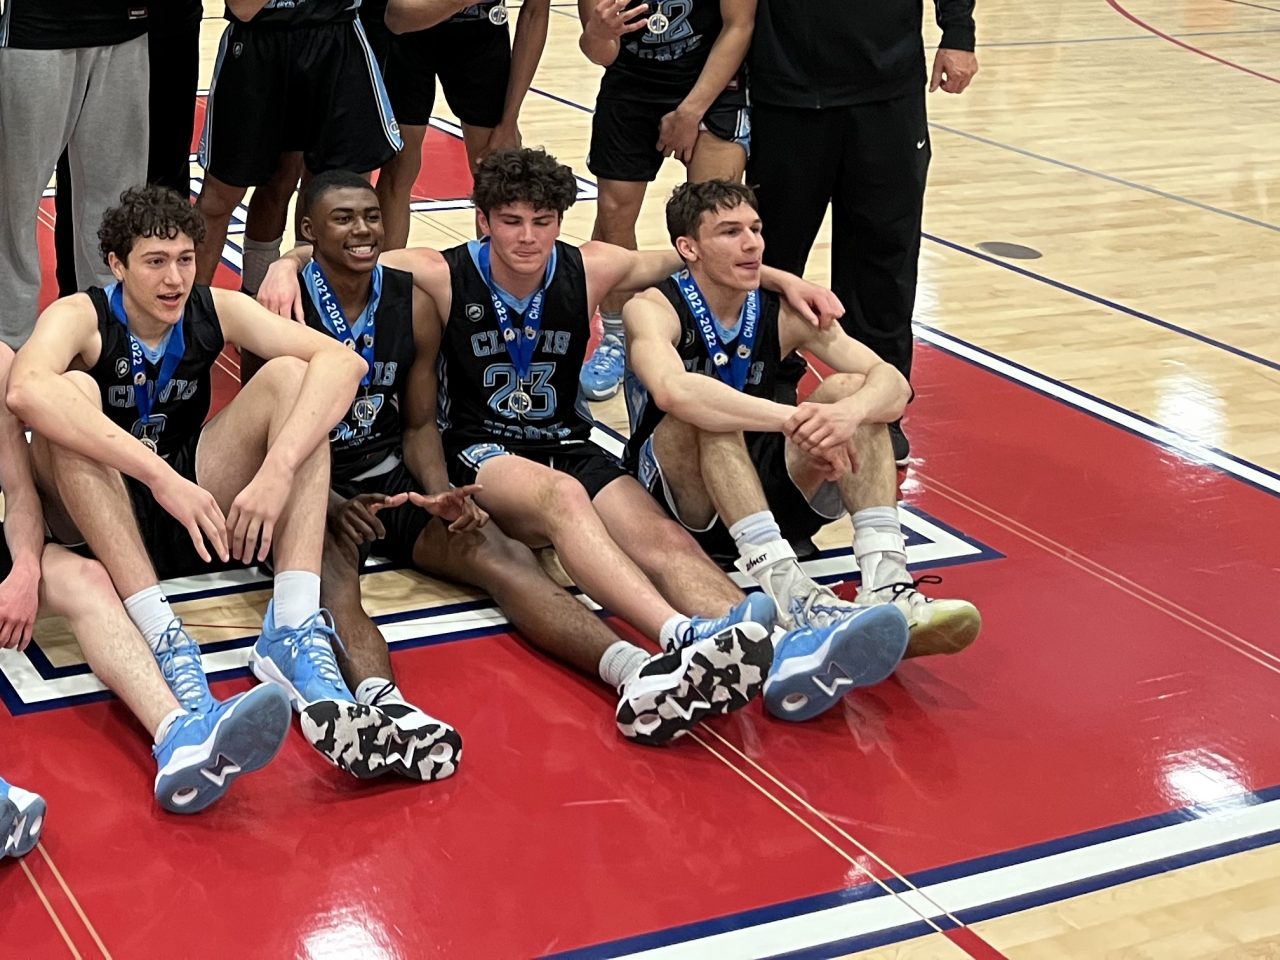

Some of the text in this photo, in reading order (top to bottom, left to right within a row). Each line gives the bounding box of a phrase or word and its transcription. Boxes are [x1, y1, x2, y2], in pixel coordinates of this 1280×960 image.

[312, 270, 347, 334] 2021-2022
[684, 284, 717, 349] 2021-2022
[743, 290, 757, 338] CHAMPIONS
[483, 361, 558, 421] 23
